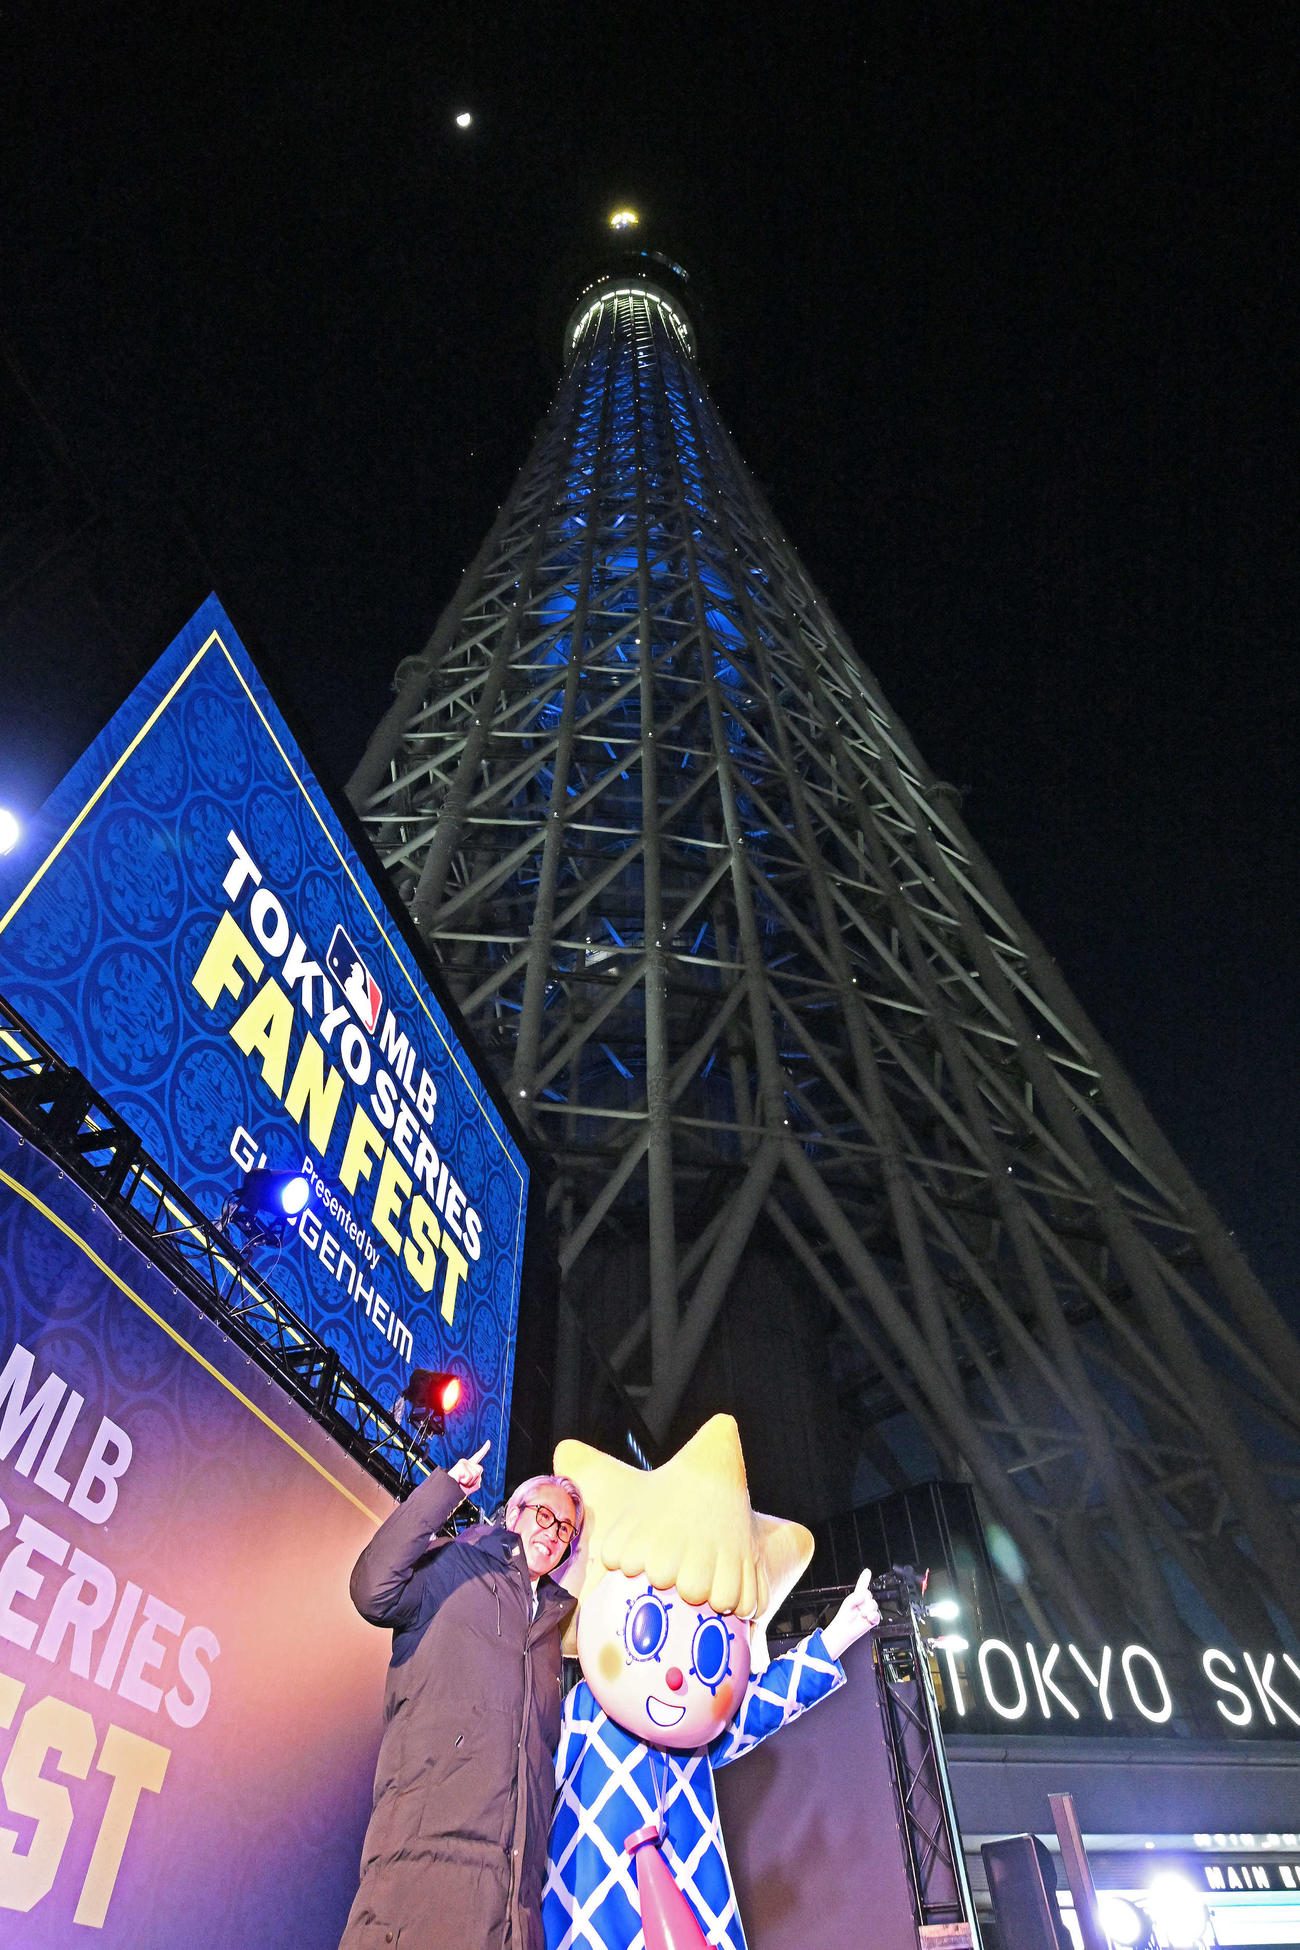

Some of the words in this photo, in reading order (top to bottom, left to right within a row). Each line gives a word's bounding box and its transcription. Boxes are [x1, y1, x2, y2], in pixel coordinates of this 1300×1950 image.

[191, 909, 345, 1157] FAN
[338, 1102, 469, 1327] FEST
[221, 829, 372, 1080] TOKYO
[370, 1069, 484, 1261] SERIES
[379, 1008, 438, 1125] MLB
[229, 1125, 415, 1364] GGENHEIM
[301, 1155, 366, 1251] Presented
[364, 1236, 381, 1270] by
[0, 1342, 133, 1525] MLB
[0, 1497, 222, 1729] ERIES
[943, 1638, 1173, 1724] TOKYO
[1204, 1866, 1269, 1889] MAIN
